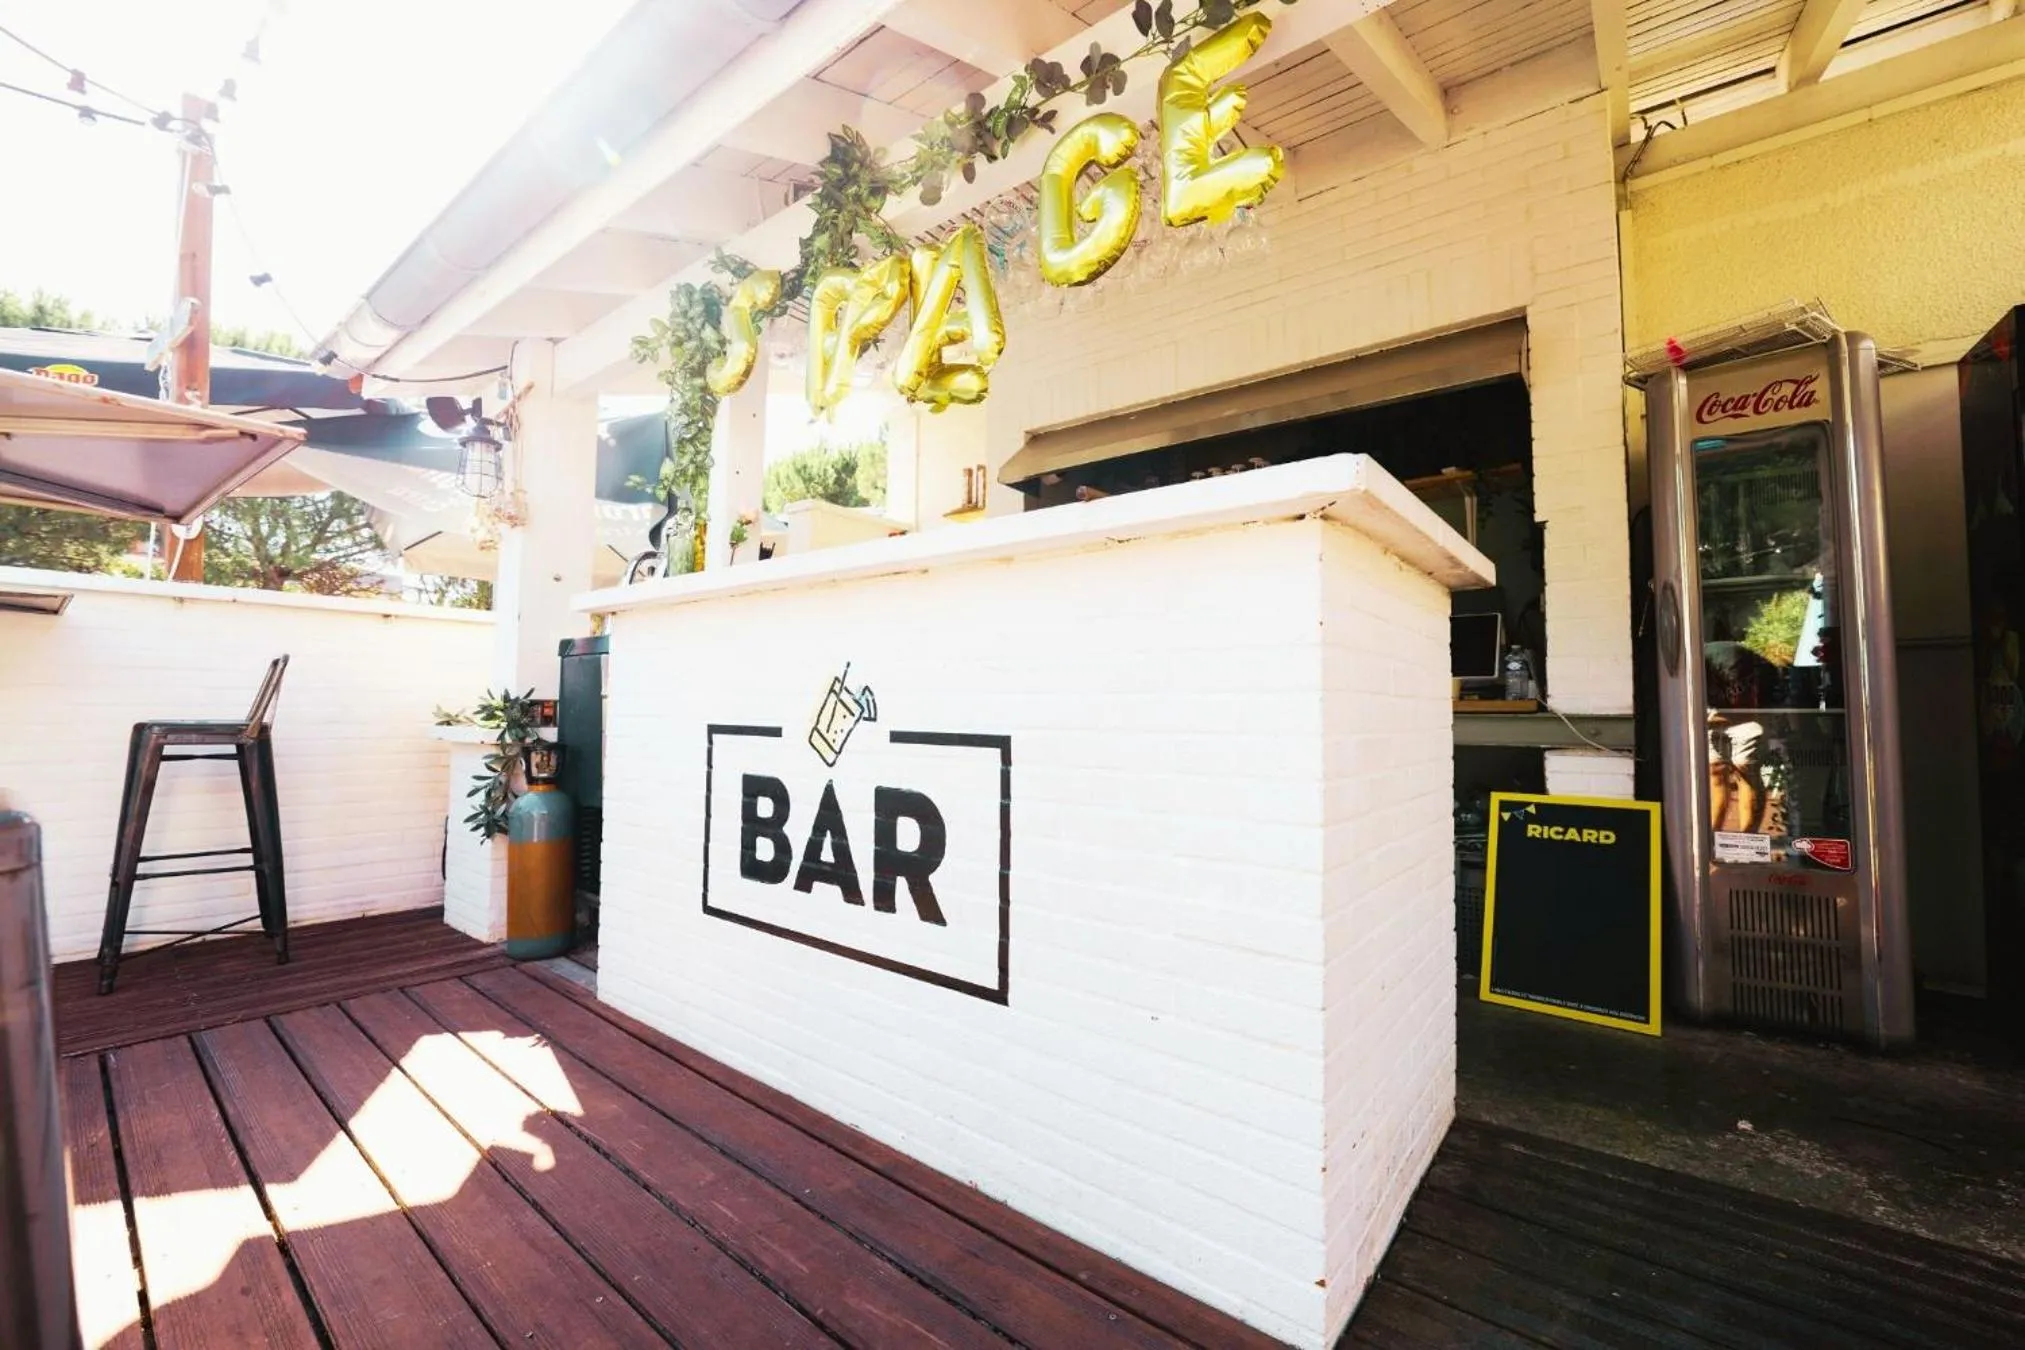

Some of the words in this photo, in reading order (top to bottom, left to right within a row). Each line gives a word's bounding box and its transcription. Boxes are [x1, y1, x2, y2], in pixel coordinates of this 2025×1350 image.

[1696, 372, 1819, 425] Coca-Cola
[740, 773, 947, 927] BAR
[1527, 824, 1616, 845] RICARD
